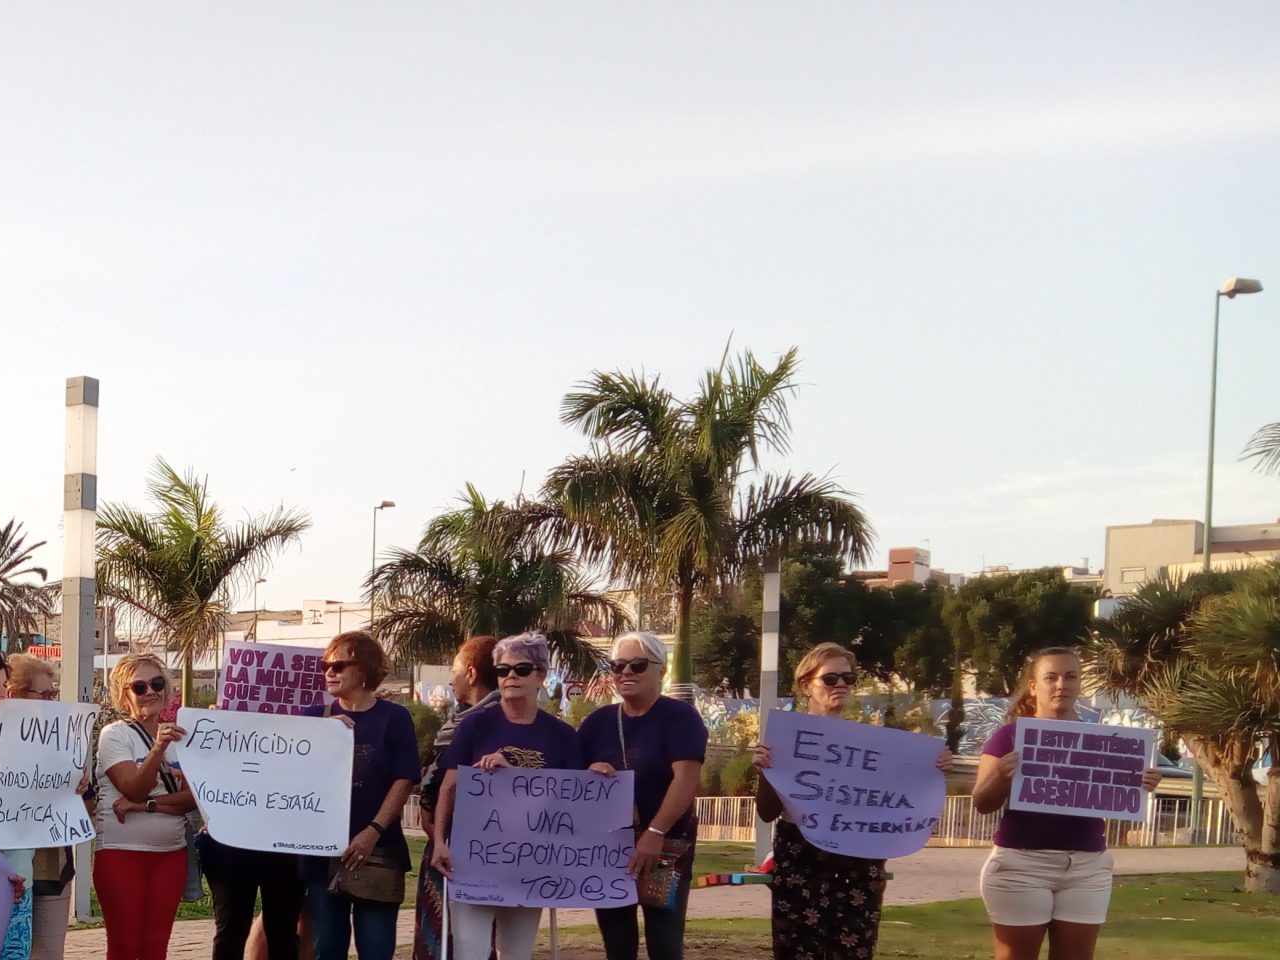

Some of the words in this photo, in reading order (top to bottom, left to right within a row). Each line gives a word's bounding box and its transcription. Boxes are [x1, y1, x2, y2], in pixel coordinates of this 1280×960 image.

[229, 648, 268, 668] VOY
[271, 652, 285, 670] A
[226, 666, 249, 684] LA
[256, 668, 326, 691] MUJER
[224, 683, 260, 701] QUE
[266, 688, 294, 704] ME
[299, 690, 325, 706] DA
[20, 716, 60, 751] UNA
[793, 729, 882, 771] ESTE
[30, 764, 71, 790] AGENDA
[512, 775, 620, 802] AGREDEN
[266, 791, 325, 813] ESTATAL
[1019, 777, 1140, 813] ASESINANDO
[483, 809, 502, 832] A
[526, 809, 574, 836] UNA
[470, 840, 633, 868] RESPONDEMOS
